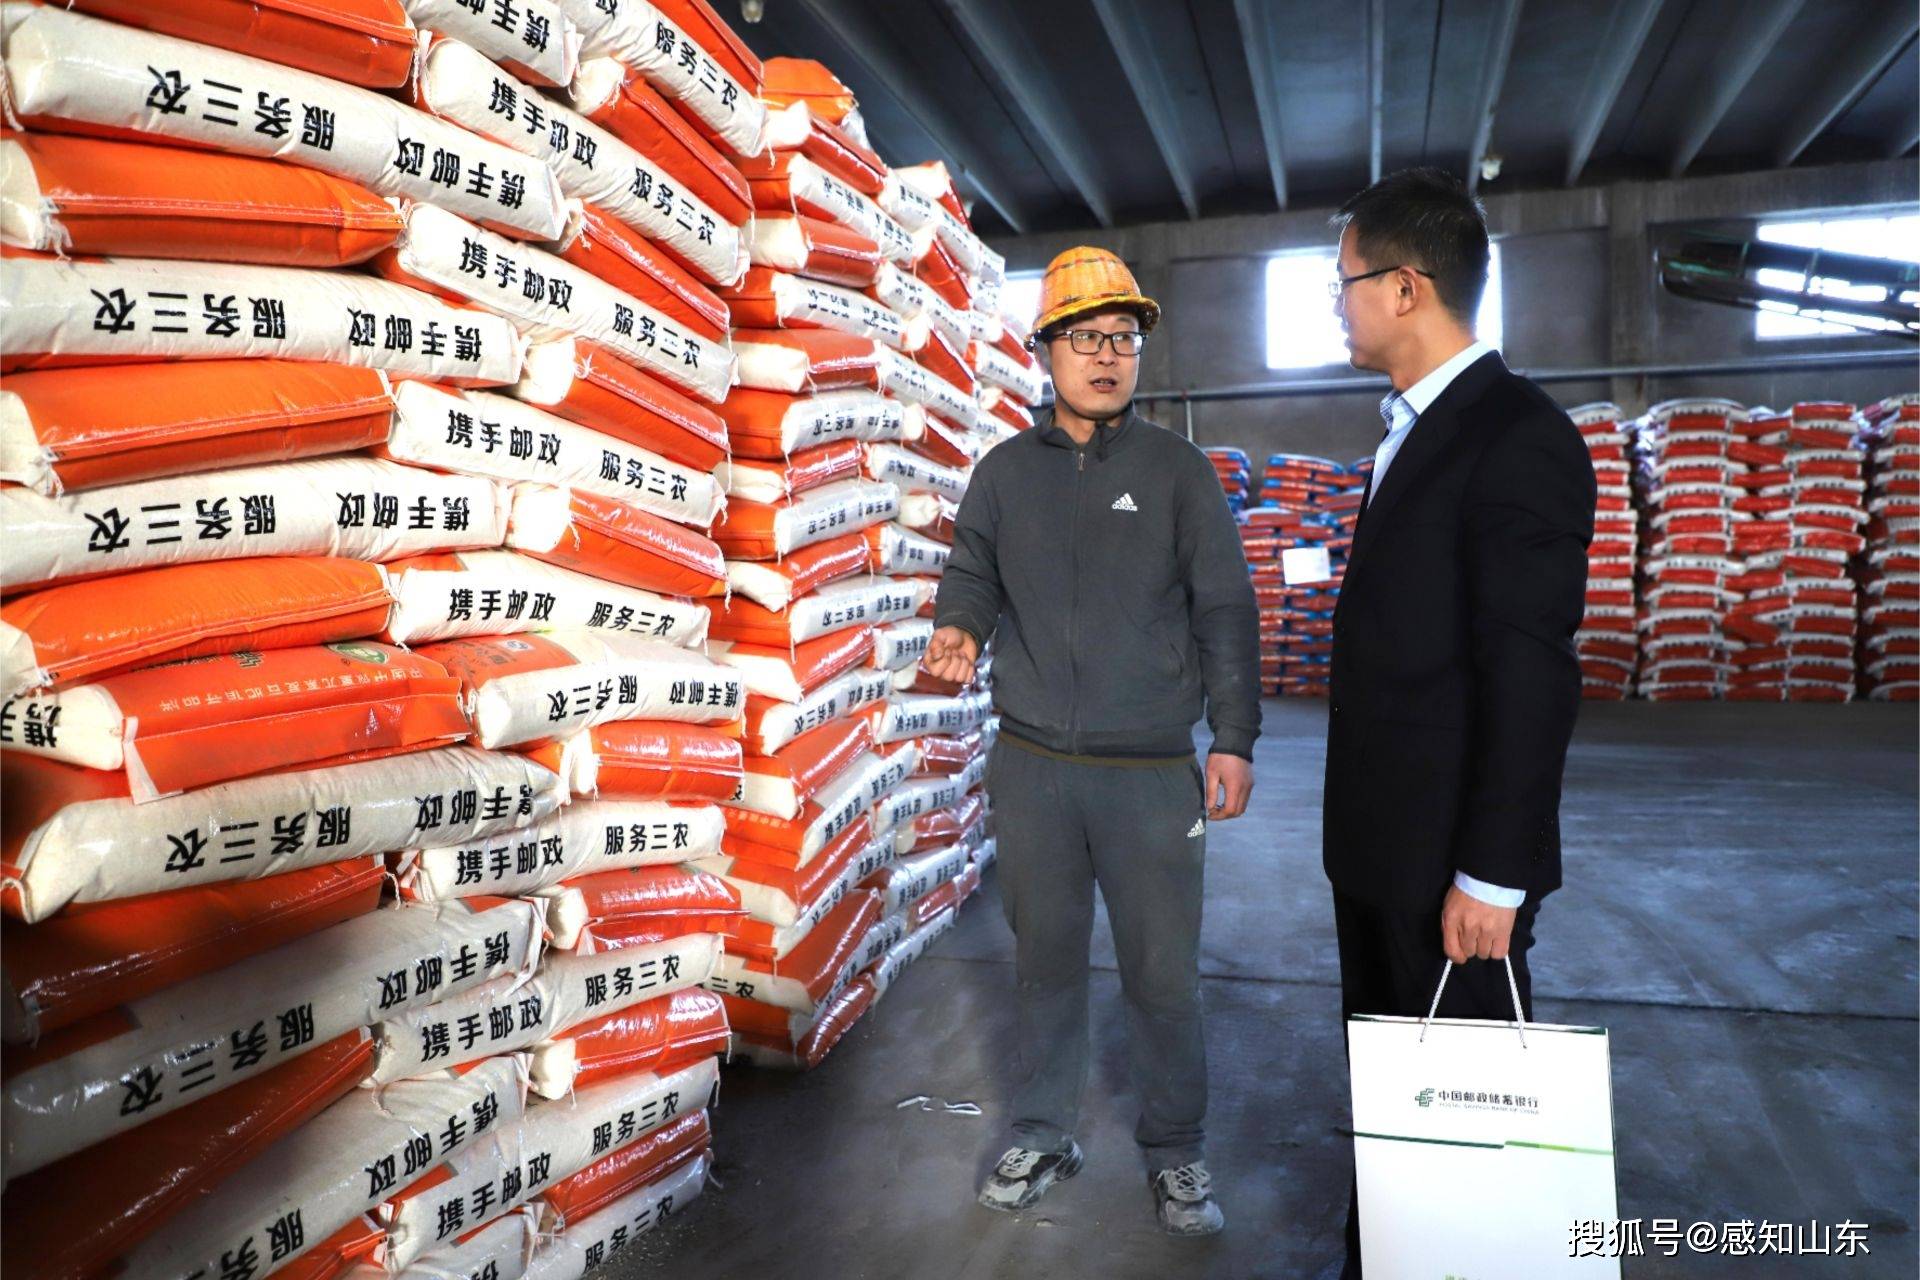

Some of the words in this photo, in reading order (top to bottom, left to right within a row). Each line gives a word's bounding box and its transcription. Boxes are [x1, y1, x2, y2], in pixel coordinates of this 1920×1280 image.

[655, 20, 738, 112] 服务三农
[146, 65, 335, 151] 服务三农
[393, 137, 526, 209] 携手邮政
[488, 77, 598, 171] 携手邮政
[629, 166, 716, 246] 服务三农
[91, 288, 286, 339] 服务三农
[347, 305, 482, 362] 携手邮政
[458, 237, 573, 313] 携手邮政
[614, 302, 701, 368] 服务三农
[446, 409, 562, 466] 携手邮政
[598, 449, 688, 502] 服务三农
[84, 494, 277, 553] 服务三农
[335, 491, 470, 532] 携手邮政
[448, 588, 556, 622] 携手邮政
[587, 601, 676, 637] 服务三农
[548, 675, 638, 722] 服务三农
[669, 675, 740, 708] 携手邮政
[164, 805, 350, 873] 服务三农
[455, 835, 563, 886] 携手邮政
[604, 822, 690, 855] 服务三农
[376, 931, 511, 1010] 携手邮政
[421, 996, 544, 1063] 携手邮政
[584, 954, 682, 1009] 服务三农
[120, 1002, 315, 1118] 服务三农
[1438, 1089, 1539, 1108] 中国邮政储蓄银行
[364, 1091, 498, 1200] 携手邮政
[437, 1151, 552, 1241] 携手邮政
[590, 1090, 681, 1157] 服务三农
[583, 1195, 675, 1274] 服务三农
